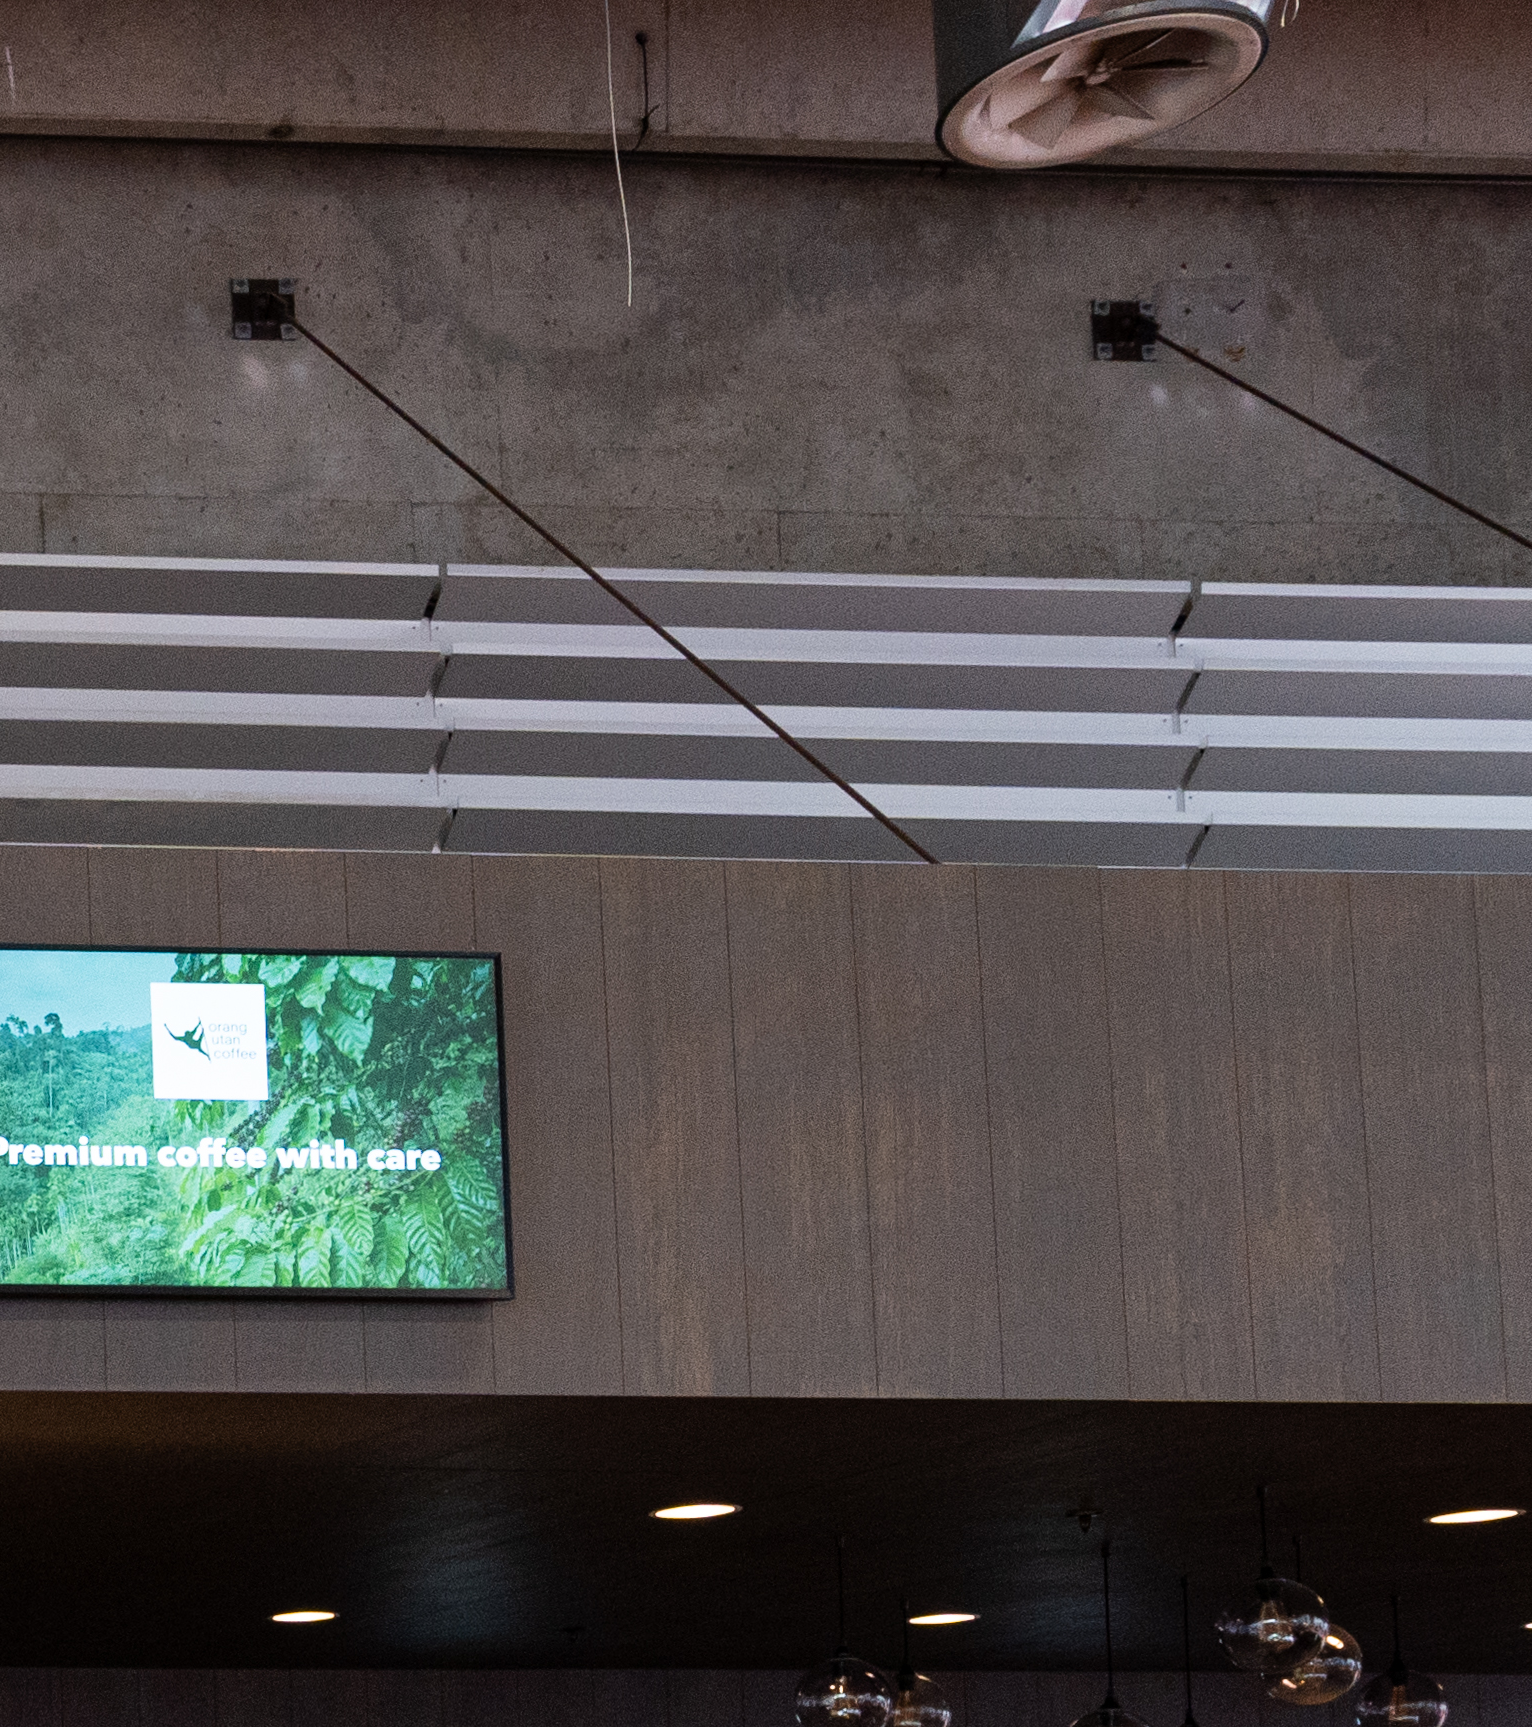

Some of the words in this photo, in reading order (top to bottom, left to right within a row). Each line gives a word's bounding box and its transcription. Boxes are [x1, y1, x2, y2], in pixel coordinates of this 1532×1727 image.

[208, 1023, 248, 1036] orang
[211, 1033, 246, 1045] utan
[213, 1047, 257, 1059] coffee
[157, 1136, 267, 1169] coffee
[275, 1139, 357, 1169] with
[367, 1149, 441, 1171] care
